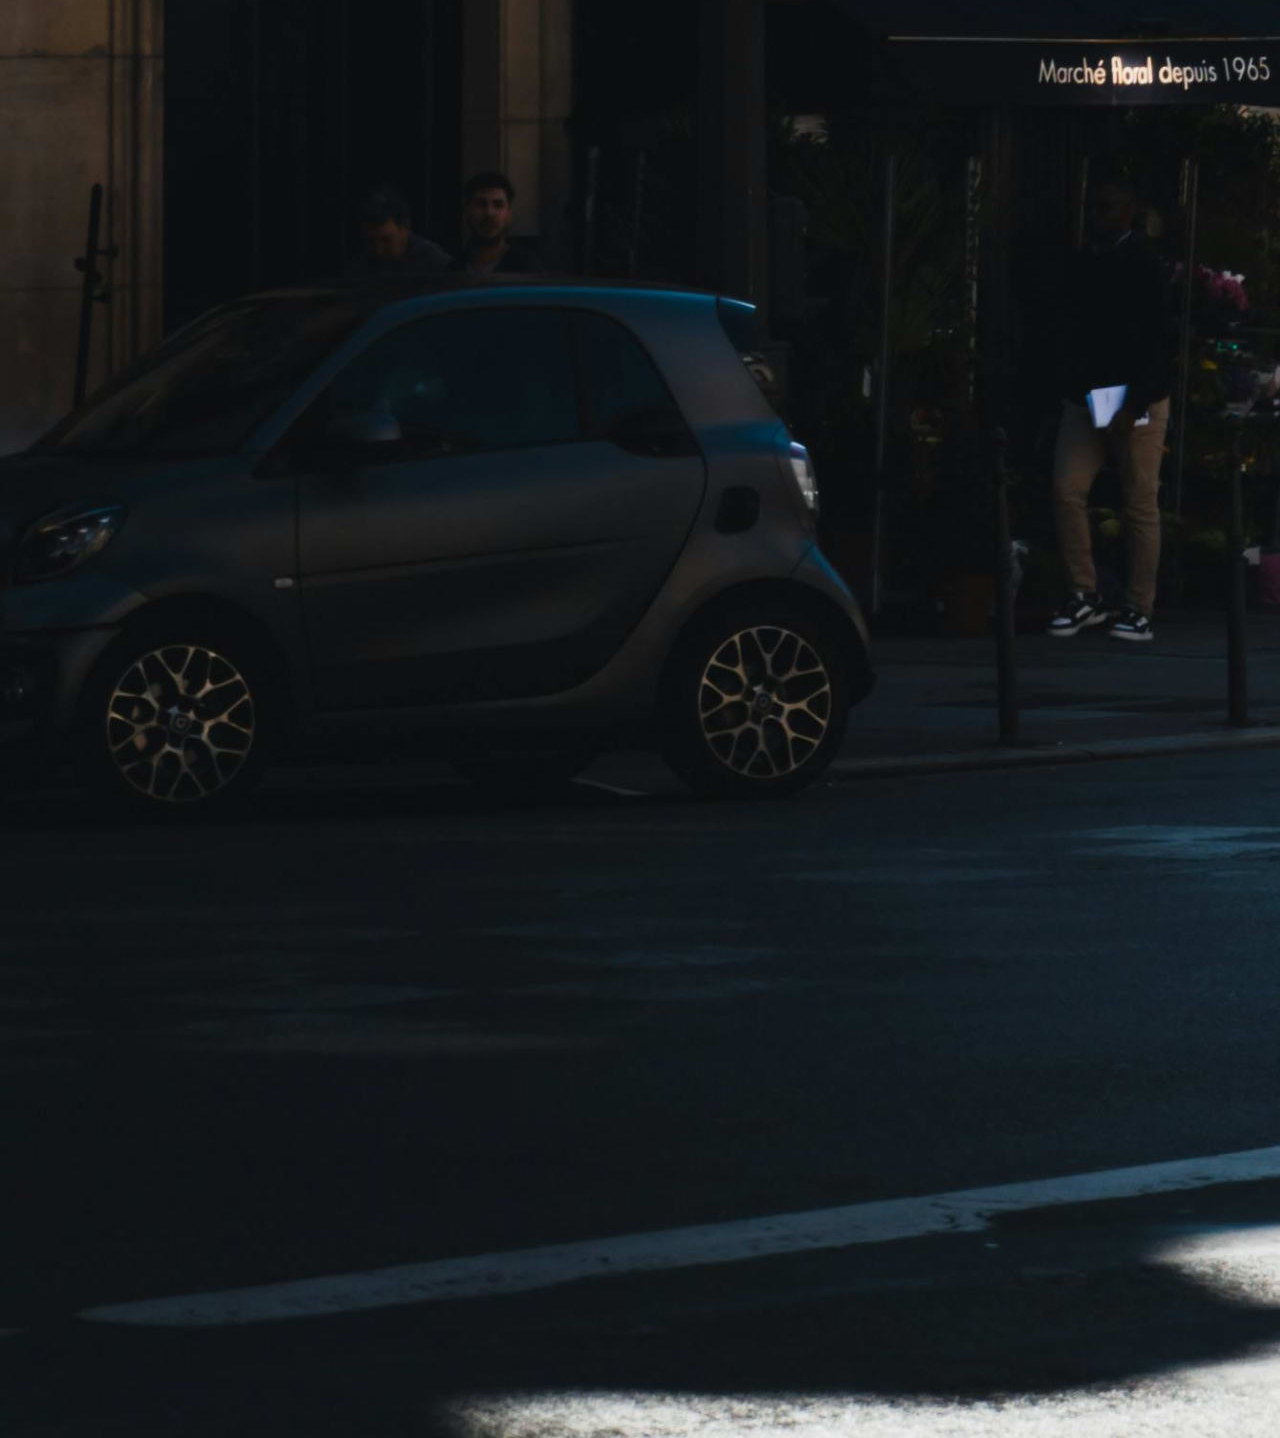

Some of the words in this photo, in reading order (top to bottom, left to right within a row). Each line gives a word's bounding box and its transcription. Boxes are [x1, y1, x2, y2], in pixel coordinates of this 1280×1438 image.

[1038, 58, 1106, 84] Marché
[1111, 56, 1153, 85] floral
[1158, 56, 1218, 90] depuis
[1222, 56, 1271, 82] 1965
